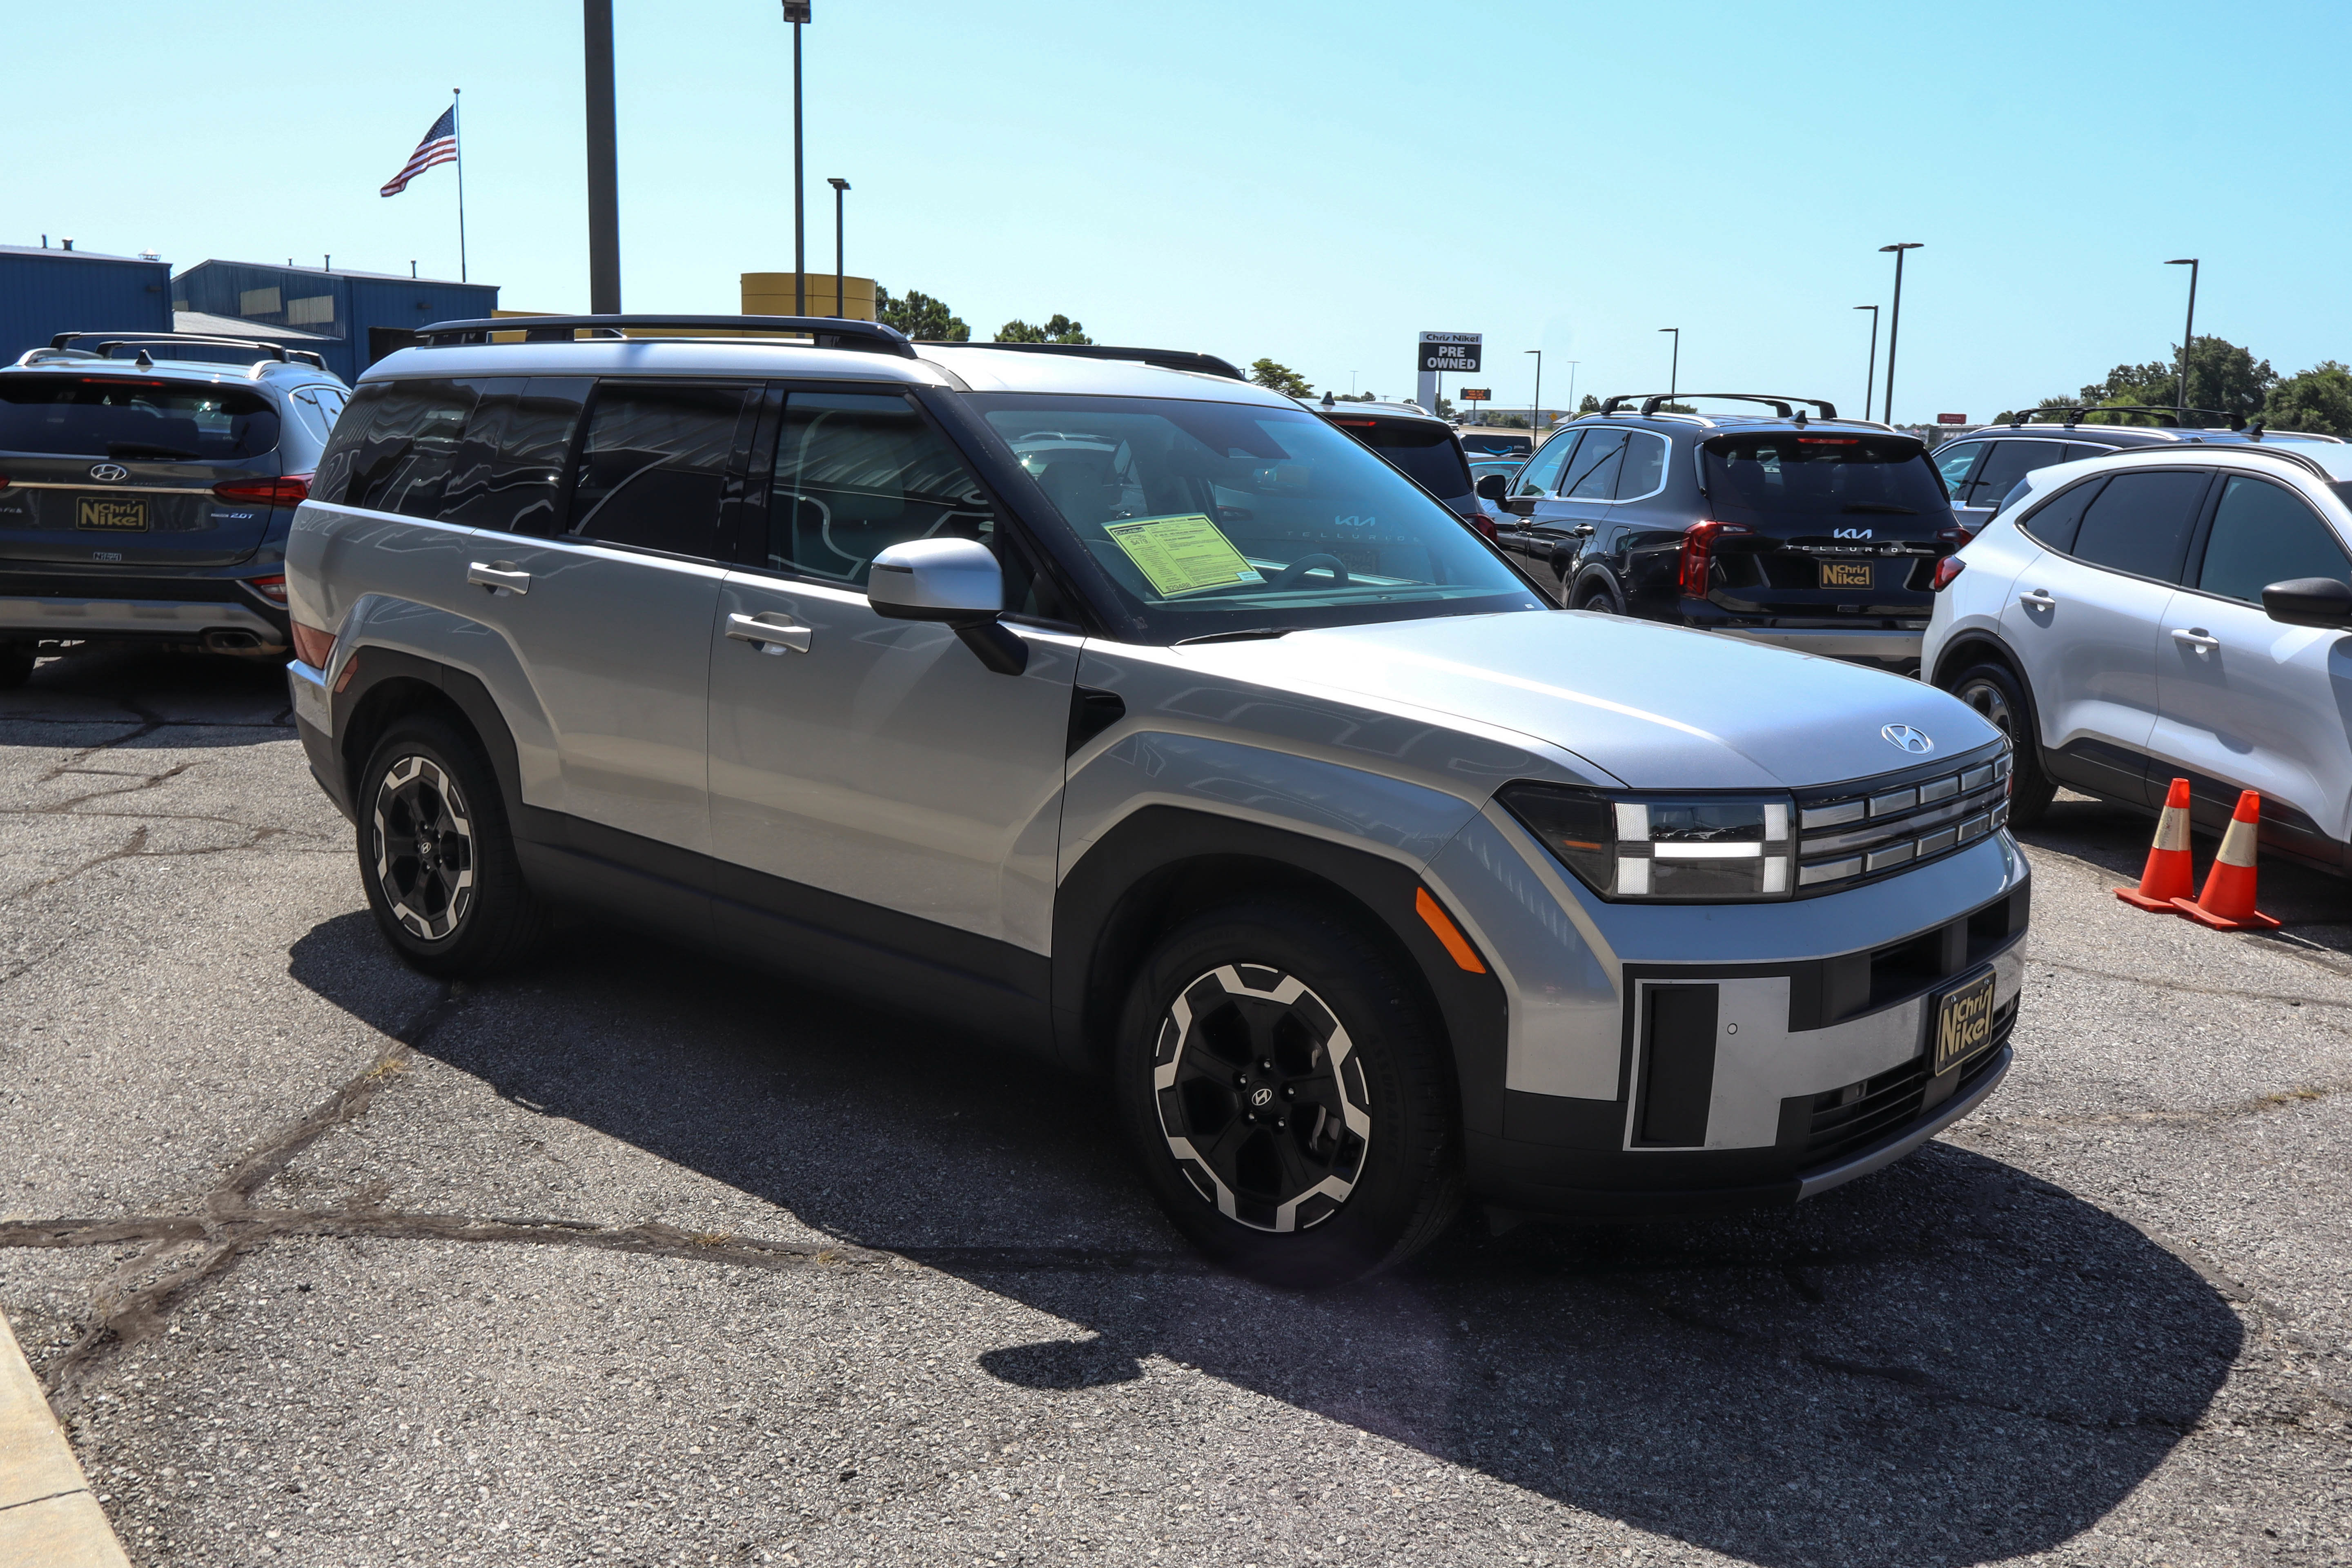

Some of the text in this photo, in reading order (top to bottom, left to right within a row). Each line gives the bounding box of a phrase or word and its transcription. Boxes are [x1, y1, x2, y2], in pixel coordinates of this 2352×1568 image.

[1439, 346, 1465, 357] PRE
[1427, 357, 1476, 370] OWNED
[81, 503, 144, 526] Nikel
[99, 503, 139, 514] Chris
[1833, 528, 1872, 539] KIA
[1786, 545, 1913, 553] TELLURIDE
[1823, 565, 1869, 585] Nikel
[1837, 565, 1866, 573] Chris
[1957, 989, 1989, 1022] Chris
[1940, 984, 1993, 1062] Nikel
